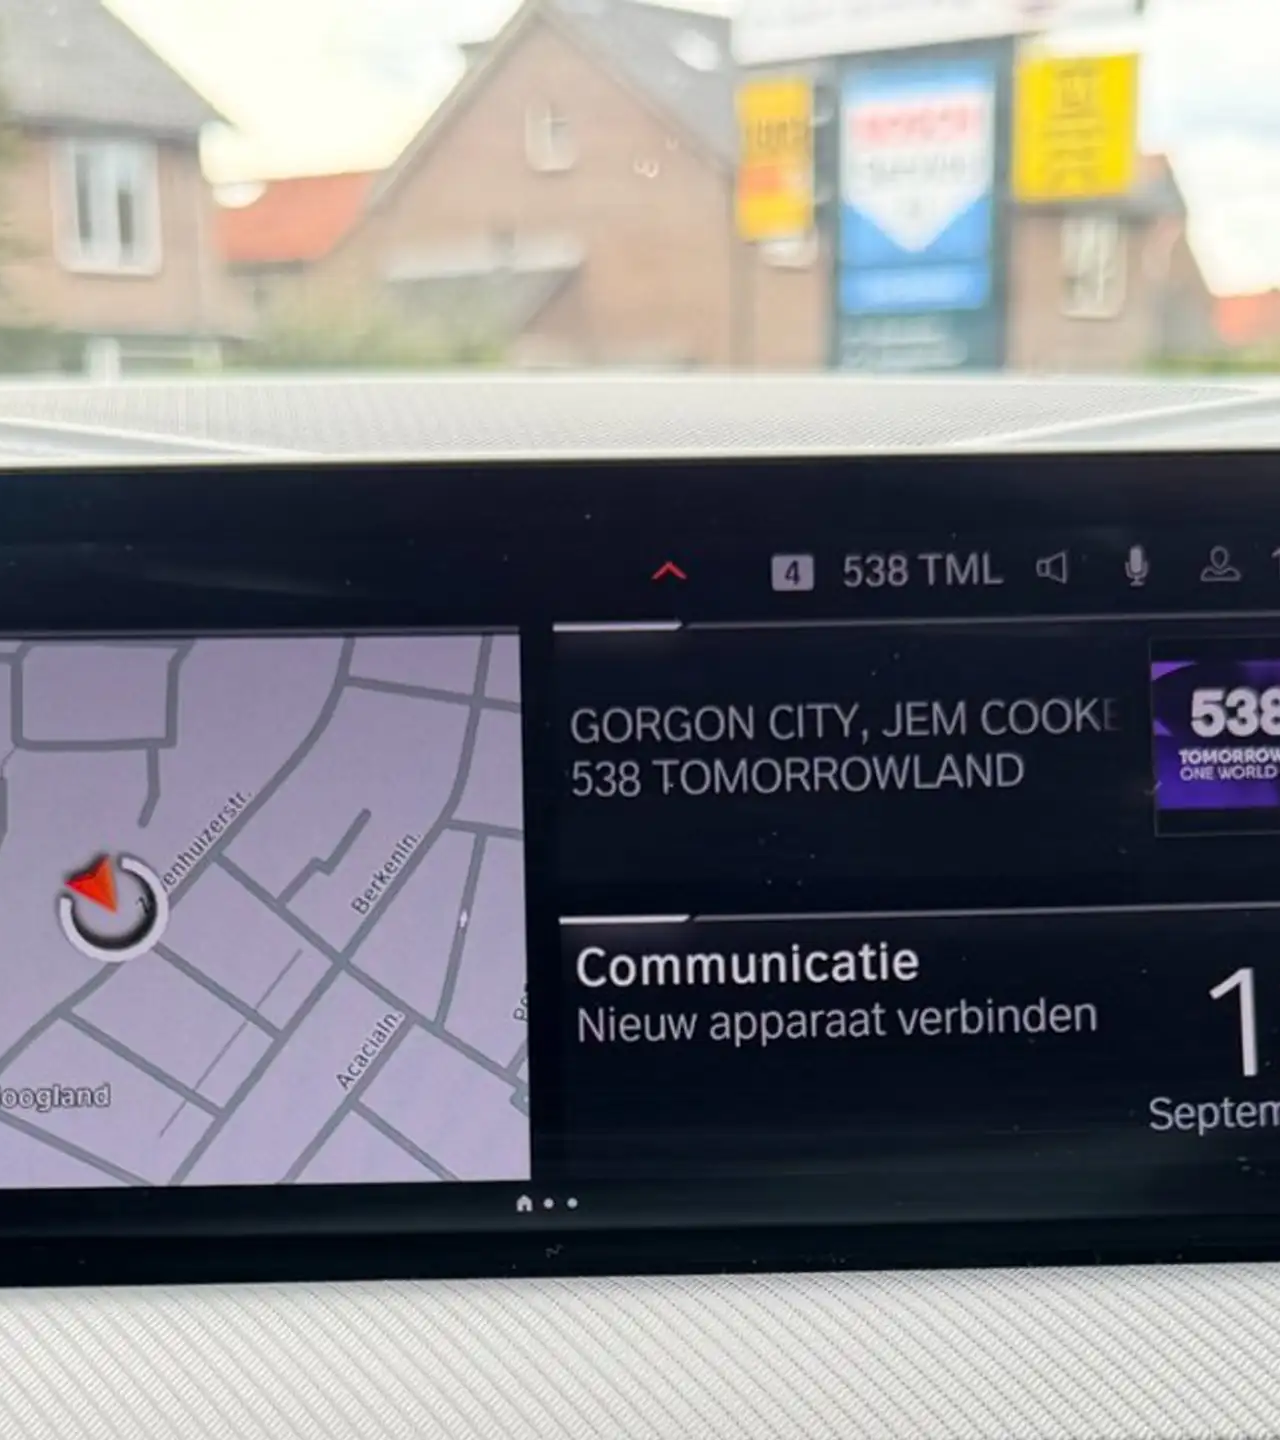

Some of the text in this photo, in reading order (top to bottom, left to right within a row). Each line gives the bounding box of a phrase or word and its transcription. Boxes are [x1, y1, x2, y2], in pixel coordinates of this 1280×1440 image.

[784, 560, 803, 586] 4
[842, 554, 1005, 587] 538 TML
[570, 705, 755, 744] GORGON
[768, 702, 870, 744] CITY,
[881, 700, 968, 737] JEM
[571, 752, 1025, 798] 538 TOMORROWLAND
[1179, 767, 1215, 781] ONE
[1218, 766, 1278, 780] WORLD
[576, 942, 920, 987] Communicatie
[576, 997, 1098, 1047] Nieuw apparaat verbinden
